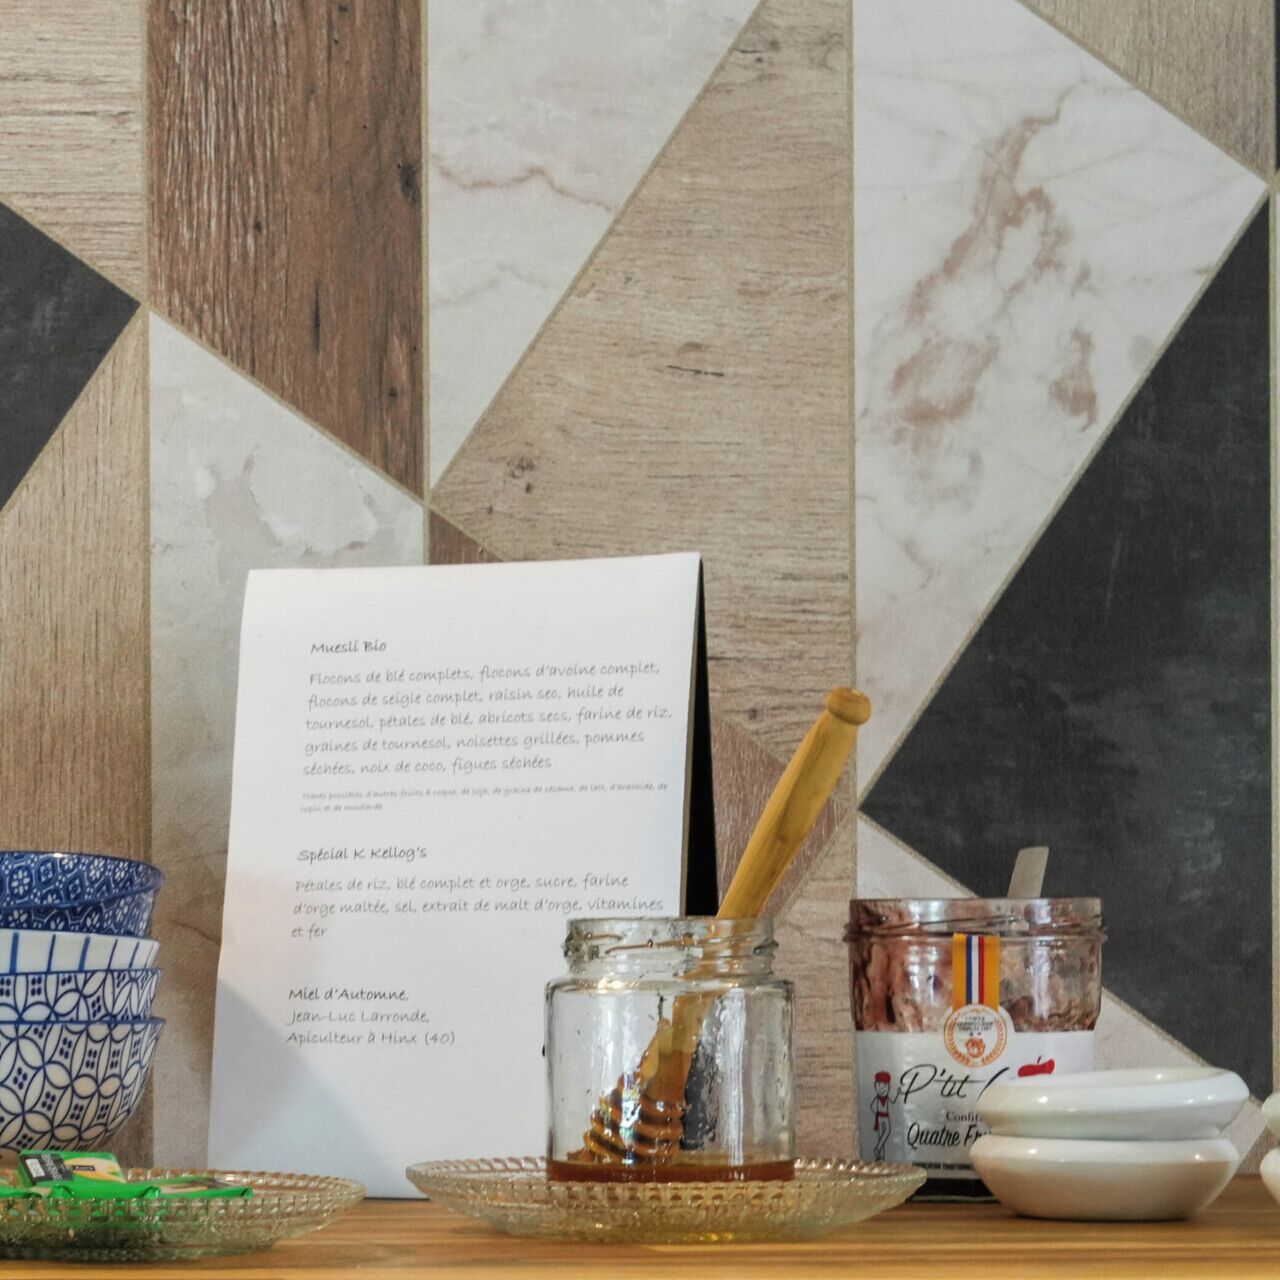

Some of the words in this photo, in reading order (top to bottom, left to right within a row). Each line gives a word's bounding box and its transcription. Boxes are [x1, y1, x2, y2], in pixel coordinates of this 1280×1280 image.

[311, 639, 359, 654] Muesli
[364, 639, 387, 652] Bio
[309, 673, 361, 685] Flocons
[366, 671, 381, 683] de
[386, 669, 405, 682] blé
[409, 667, 474, 684] complets,
[480, 665, 531, 681] flocons
[536, 663, 596, 677] d'avoine
[600, 661, 660, 677] complet,
[308, 695, 357, 711] flocons
[363, 694, 378, 705] de
[382, 692, 422, 708] seigle
[426, 690, 484, 705] complet,
[489, 688, 533, 701] raisin
[537, 688, 561, 700] sec,
[568, 686, 604, 698] huile
[608, 685, 624, 697] de
[306, 717, 374, 730] tournesol,
[379, 715, 425, 731] pétales
[431, 714, 446, 726] de
[479, 710, 534, 724] abricots
[539, 710, 571, 722] secs,
[576, 706, 622, 724] farine
[626, 707, 642, 719] de
[647, 706, 672, 720] riz,
[305, 739, 357, 757] graines
[363, 738, 378, 750] de
[382, 736, 451, 750] tournesol,
[457, 734, 518, 748] noisettes
[523, 732, 580, 749] grillées,
[585, 731, 644, 747] pommes
[361, 761, 390, 773] noix
[395, 760, 410, 773] de
[415, 760, 446, 772] coco,
[452, 757, 497, 775] figues
[502, 756, 552, 769] séchées
[297, 848, 349, 866] Spécial
[354, 849, 366, 859] K
[371, 847, 427, 862] Kellog's
[295, 879, 342, 892] Pétales
[347, 879, 363, 889] de
[367, 877, 391, 890] riz,
[397, 876, 416, 889] blé
[420, 876, 475, 893] complet
[480, 879, 491, 888] et
[496, 879, 531, 892] orge,
[536, 876, 578, 888] sucre,
[583, 872, 628, 891] farine
[293, 903, 335, 917] d'orge
[394, 900, 417, 912] sel,
[422, 899, 469, 912] extrait
[474, 899, 490, 911] de
[494, 898, 529, 911] malt
[534, 898, 583, 914] d'orge,
[588, 896, 664, 910] vitamines
[291, 926, 303, 937] et
[308, 924, 327, 940] fer
[288, 987, 319, 1001] Miel
[324, 985, 409, 1002] d'Automne,
[361, 1010, 430, 1023] Larronde,
[286, 1032, 363, 1048] Apiculteur
[368, 1030, 375, 1043] à
[382, 1032, 418, 1044] Hinx
[424, 1031, 455, 1045] (40)
[907, 1122, 960, 1149] Quatre
